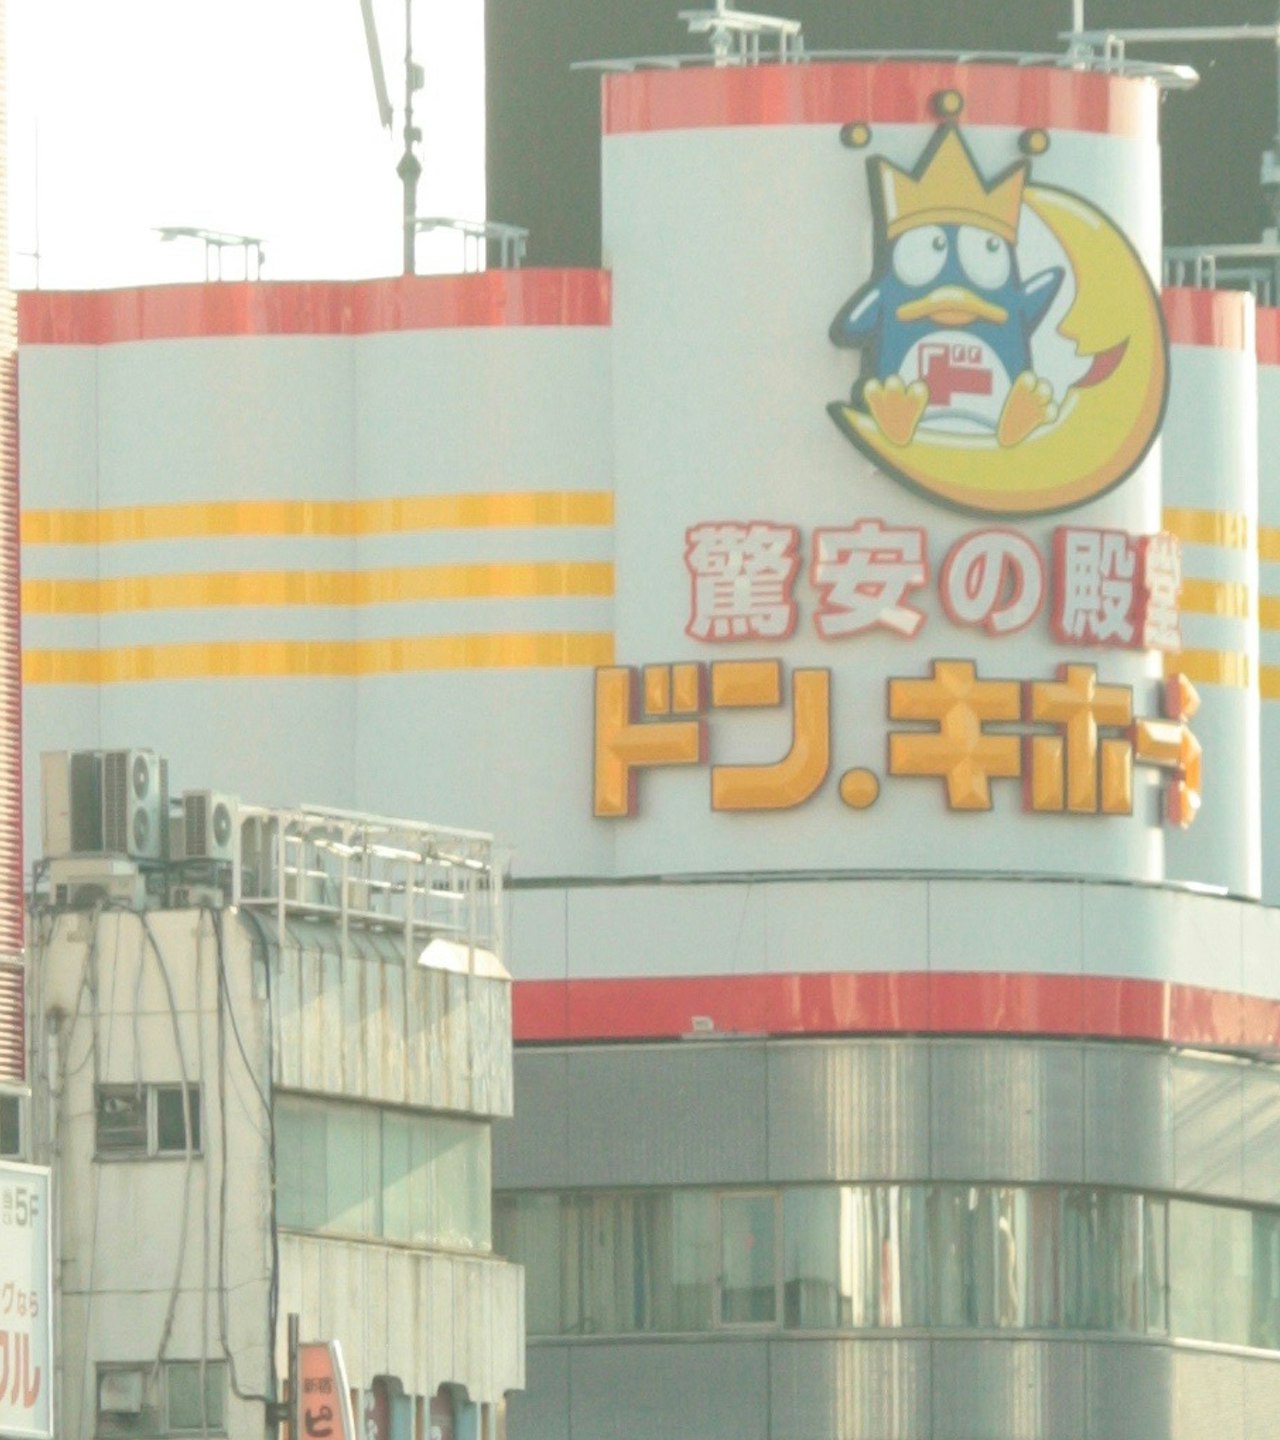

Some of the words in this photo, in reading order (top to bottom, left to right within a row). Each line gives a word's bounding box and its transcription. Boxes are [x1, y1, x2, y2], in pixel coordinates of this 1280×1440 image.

[685, 519, 1181, 649] 驚安の殿堂
[17, 1188, 39, 1229] 5F
